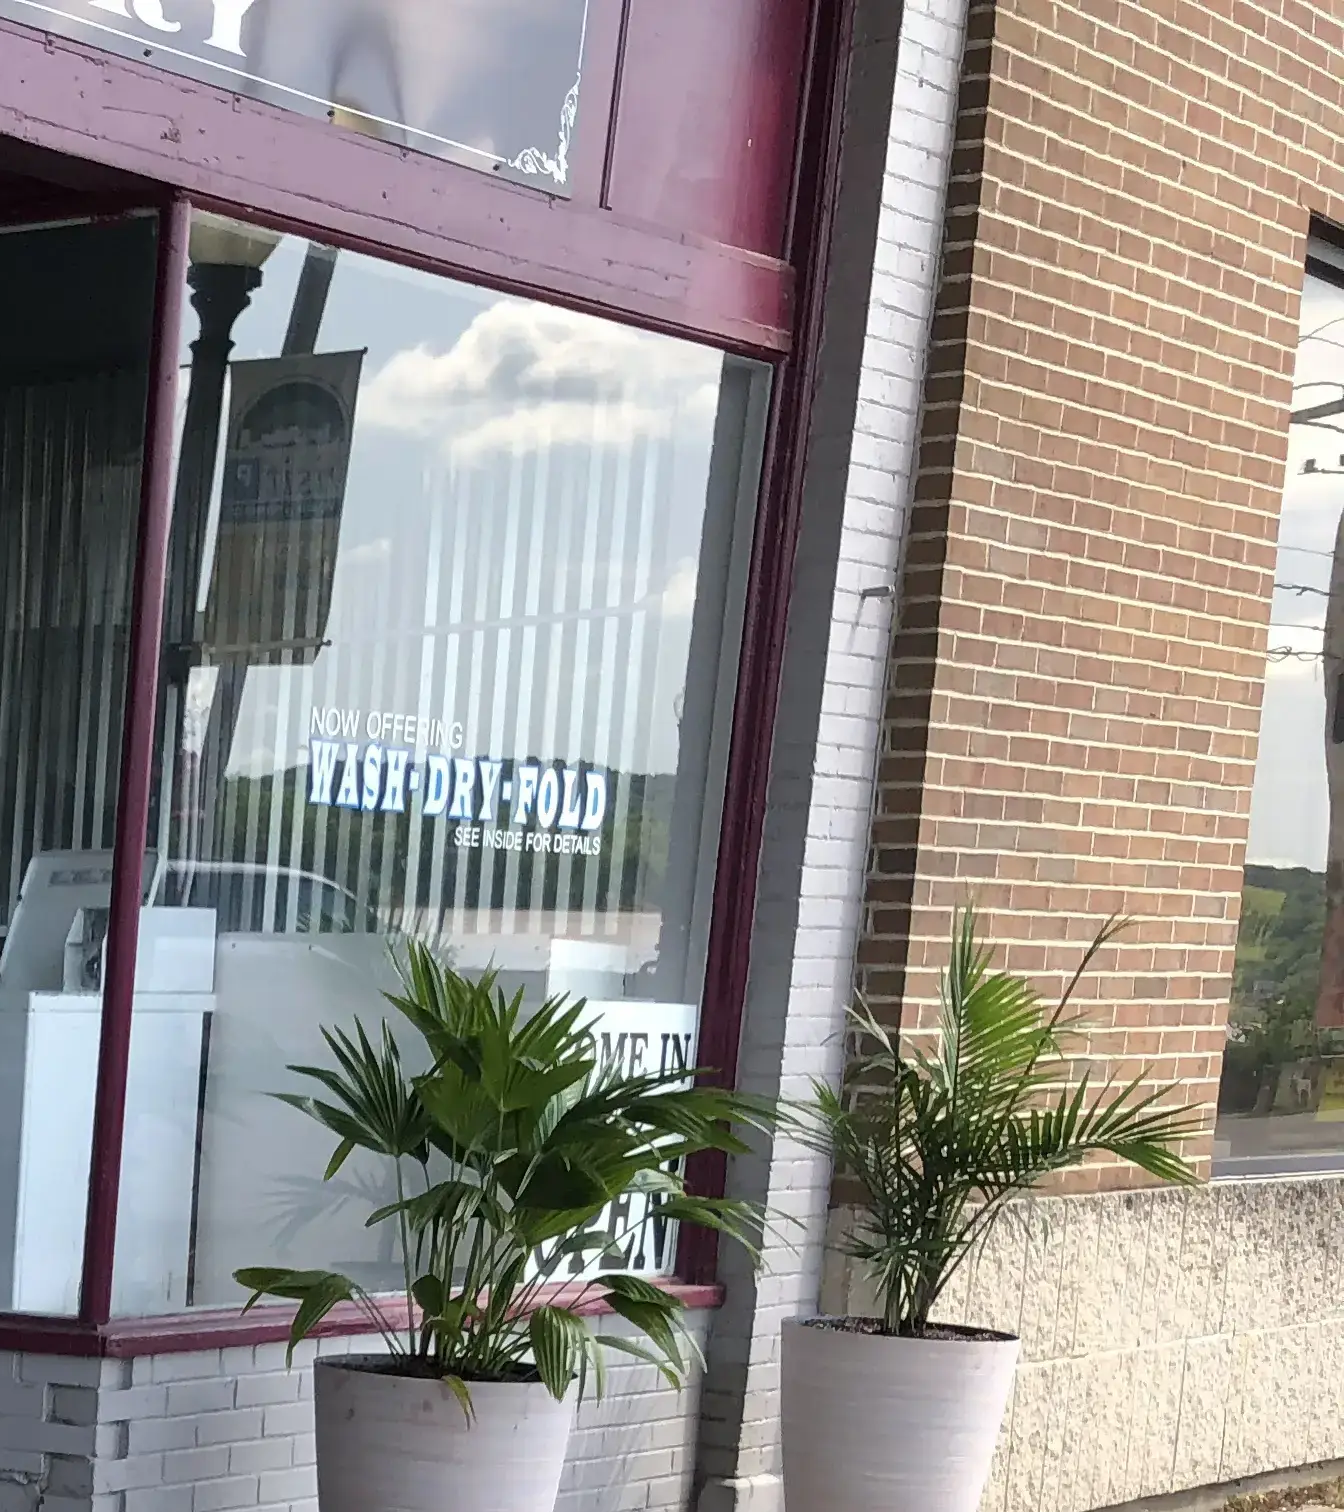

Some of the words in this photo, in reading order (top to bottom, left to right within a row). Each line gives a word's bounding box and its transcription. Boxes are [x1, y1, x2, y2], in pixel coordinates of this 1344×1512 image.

[310, 706, 359, 738] NOW
[366, 711, 462, 749] OFFERING
[454, 827, 479, 847] SEE
[483, 829, 523, 851] INSIDE
[525, 832, 550, 852] FOR
[553, 835, 601, 855] DETAILS
[570, 1031, 648, 1081] OME
[661, 1033, 691, 1084] IN
